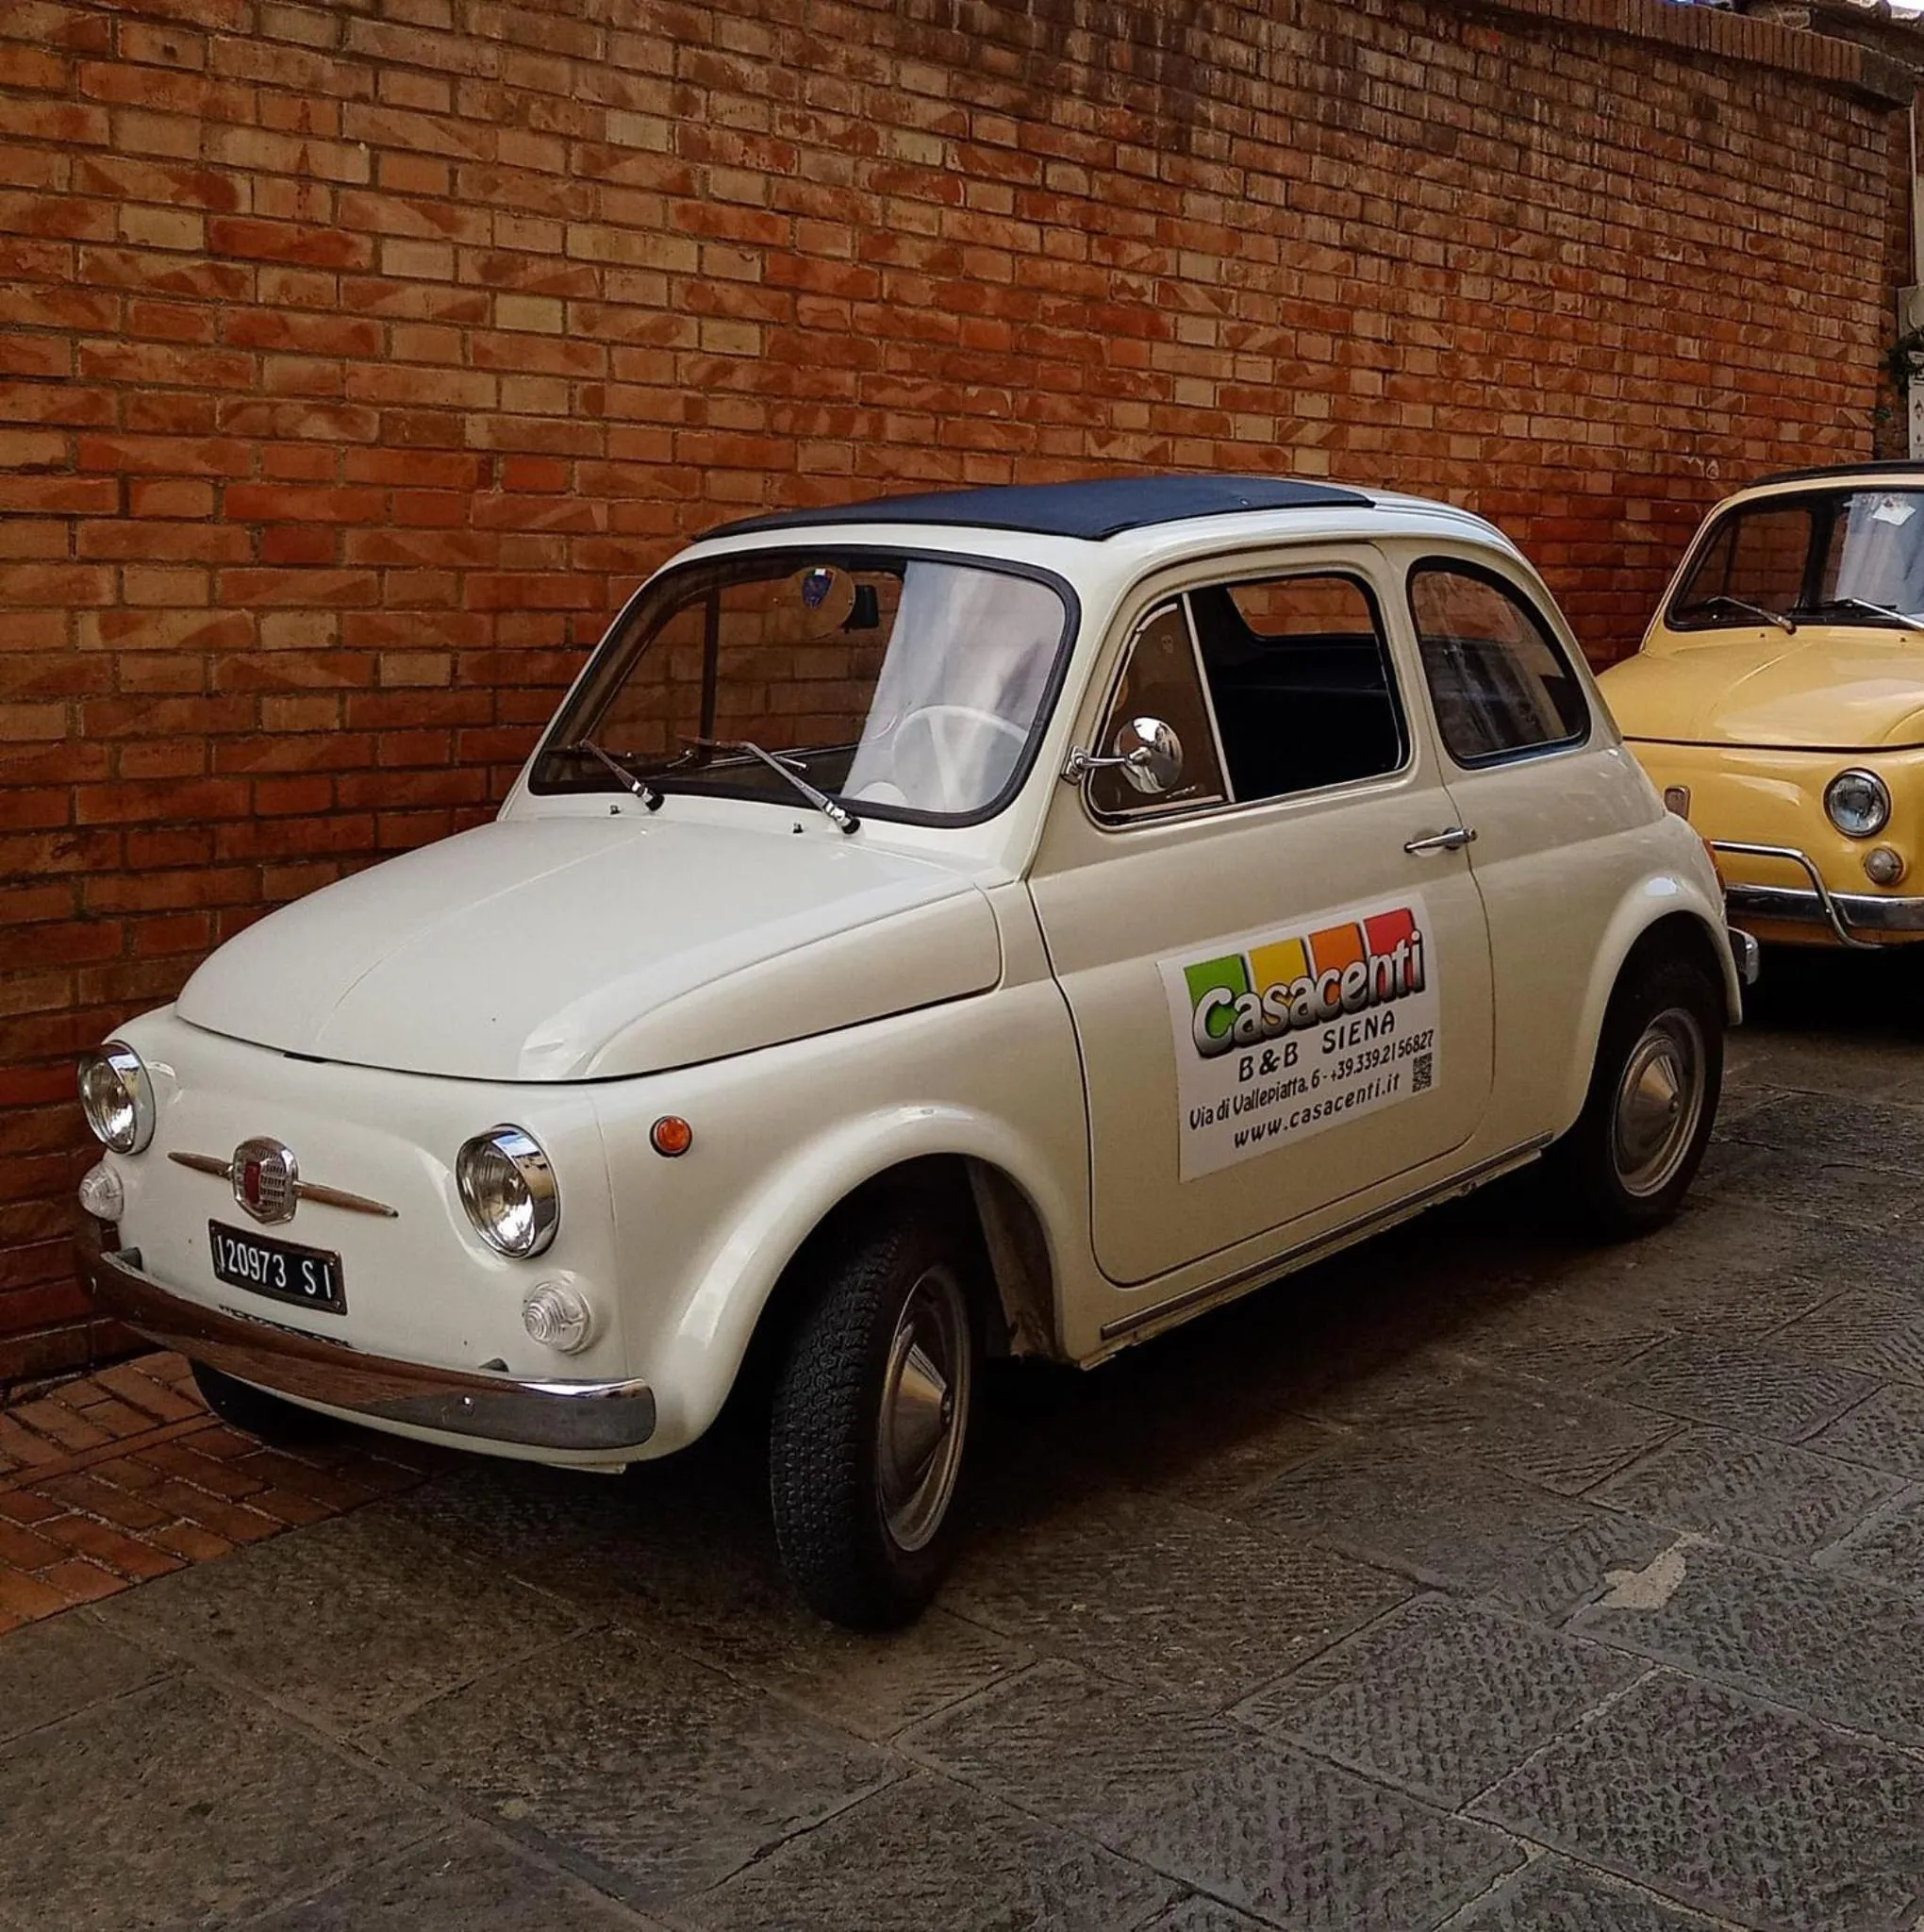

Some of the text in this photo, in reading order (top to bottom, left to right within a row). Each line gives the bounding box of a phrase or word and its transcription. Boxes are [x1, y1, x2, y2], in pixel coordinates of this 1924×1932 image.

[1192, 929, 1425, 1058] Casacenti
[1322, 1010, 1395, 1054] SIENA
[1189, 1106, 1214, 1130] Via
[1217, 1098, 1230, 1121] di
[1311, 1068, 1320, 1089] 6
[1235, 1073, 1400, 1149] www.casacenti.it
[218, 1235, 332, 1298] 120973 SI
